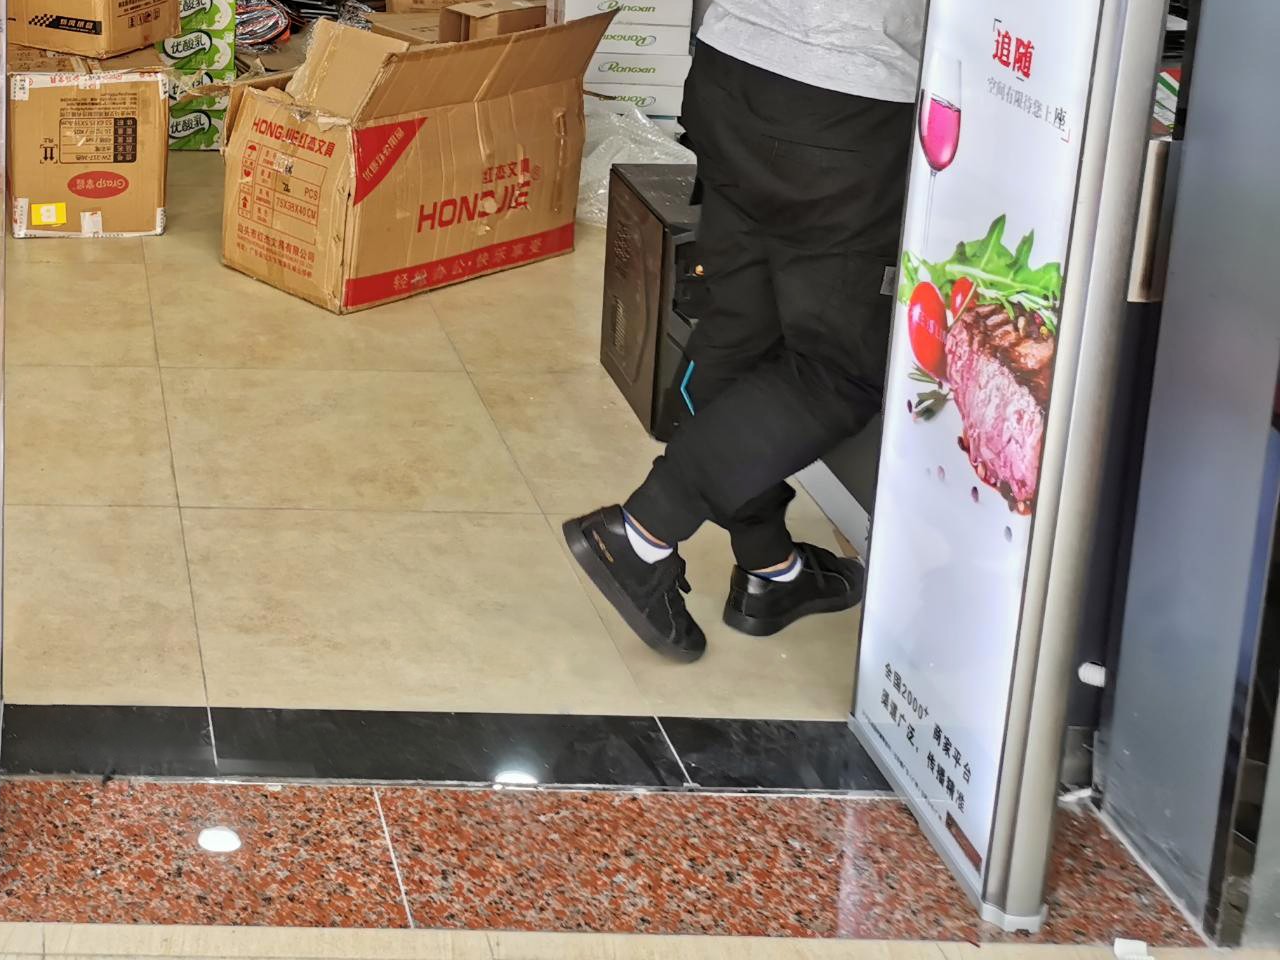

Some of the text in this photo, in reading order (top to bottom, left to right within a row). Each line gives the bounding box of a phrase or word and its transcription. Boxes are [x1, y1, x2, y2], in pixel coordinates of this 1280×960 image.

[171, 37, 206, 55] 优酸乳
[992, 29, 1035, 80] 追随
[170, 115, 205, 135] 优酸乳
[96, 178, 126, 189] Grasp
[304, 187, 319, 200] PCS
